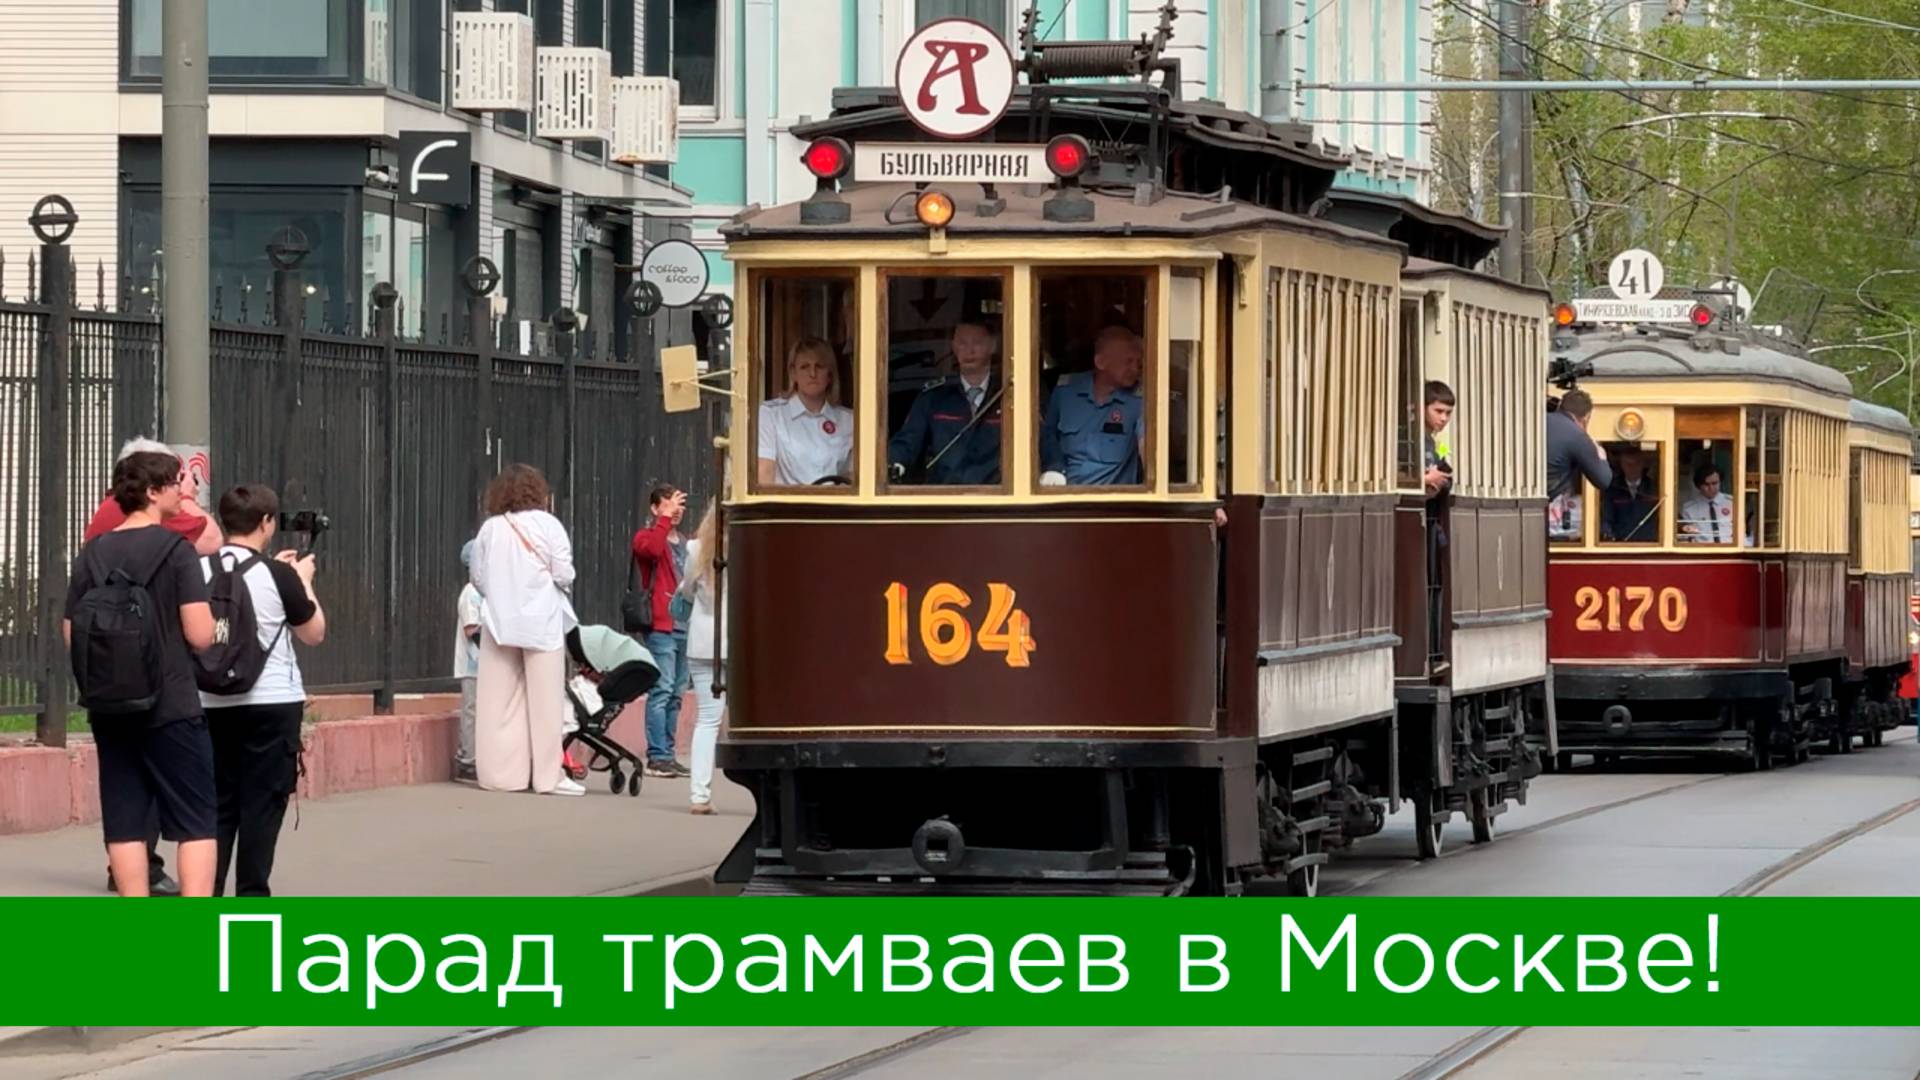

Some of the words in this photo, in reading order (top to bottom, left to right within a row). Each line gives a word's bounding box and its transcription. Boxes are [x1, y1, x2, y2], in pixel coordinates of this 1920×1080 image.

[917, 40, 990, 115] А
[880, 152, 1029, 178] БУЛЬВАРНАЯ
[648, 264, 688, 274] coffee
[665, 274, 700, 284] &food
[1617, 257, 1651, 295] 41
[884, 582, 1036, 667] 164
[1574, 586, 1688, 632] 2170
